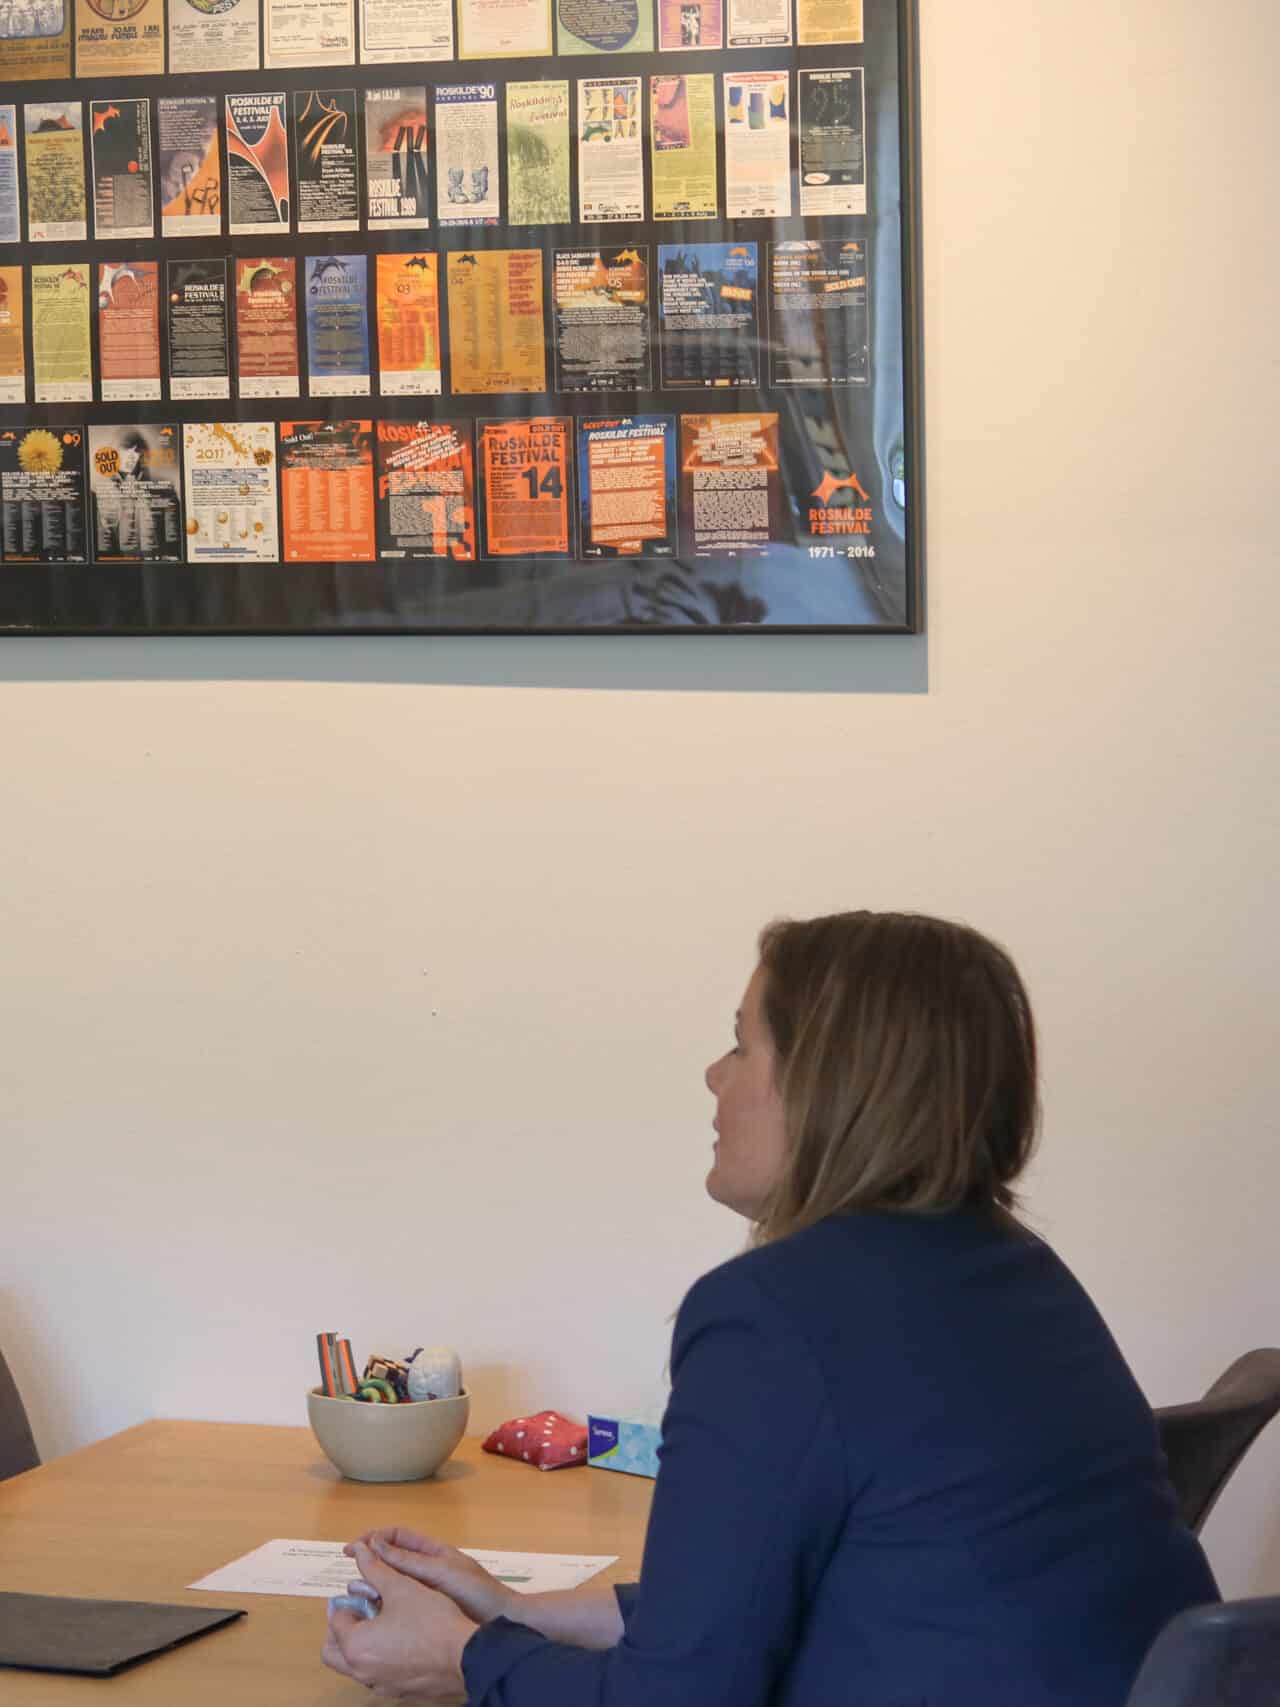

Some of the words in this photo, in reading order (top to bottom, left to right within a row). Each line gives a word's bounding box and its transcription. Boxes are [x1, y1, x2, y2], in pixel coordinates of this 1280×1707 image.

[434, 86, 477, 97] ROSKILDE
[231, 96, 272, 107] ROSKILDE
[368, 198, 401, 216] FESTIVAL
[588, 429, 628, 441] ROSKILDE
[628, 426, 666, 438] FESTIVAL
[488, 434, 561, 451] ROSKILDE
[95, 450, 119, 464] SOLD
[195, 448, 225, 460] 2011
[490, 448, 561, 465] FESTIVAL
[99, 461, 118, 475] OUT
[521, 465, 564, 499] 14
[808, 507, 873, 521] ROSKILDE
[810, 522, 872, 535] FESTIVAL
[808, 546, 835, 559] 1971
[847, 546, 876, 558] 2016
